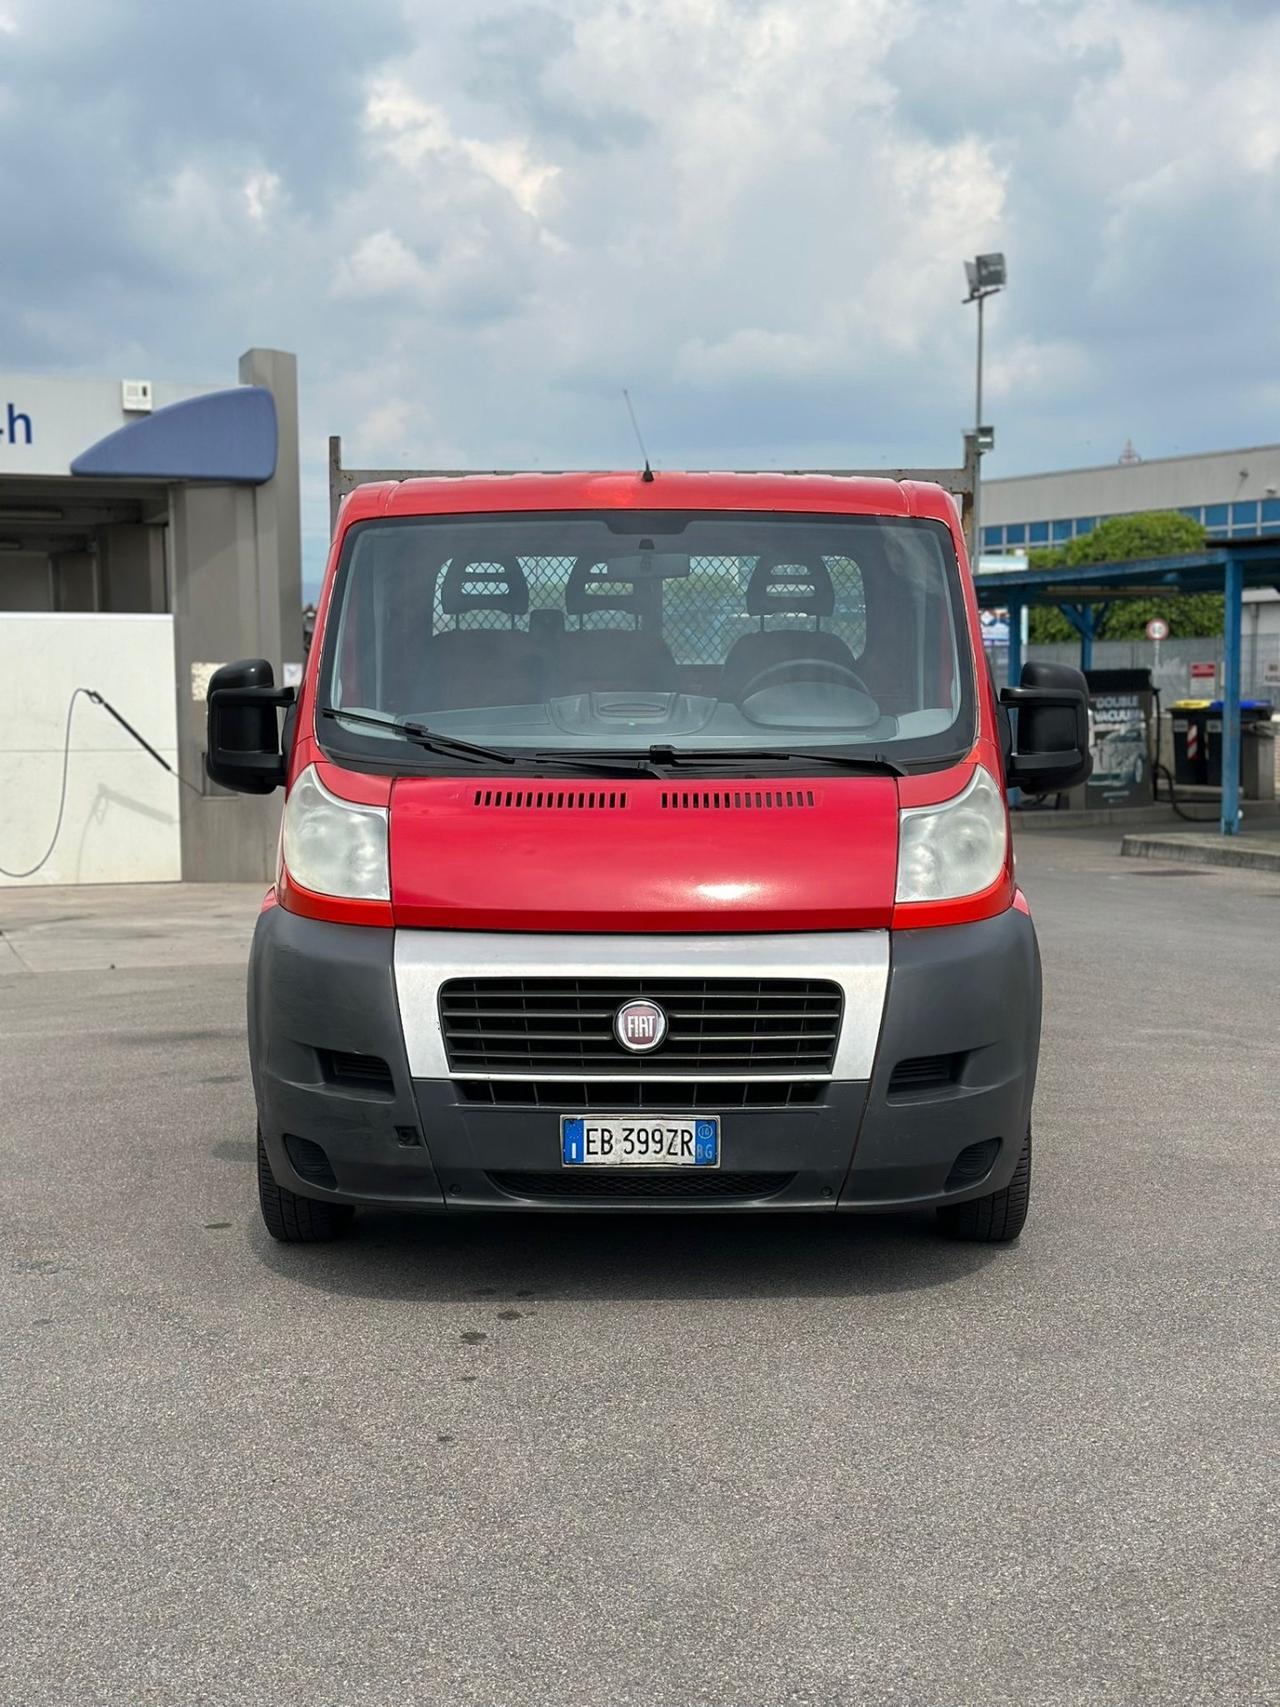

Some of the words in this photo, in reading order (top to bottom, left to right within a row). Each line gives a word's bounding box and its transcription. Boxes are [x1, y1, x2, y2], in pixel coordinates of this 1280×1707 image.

[0, 403, 32, 444] h
[1096, 695, 1139, 709] DOUBLE
[627, 1015, 655, 1038] FIAT
[586, 1127, 613, 1155] EB
[622, 1127, 694, 1157] 399ZR
[696, 1143, 713, 1160] BG
